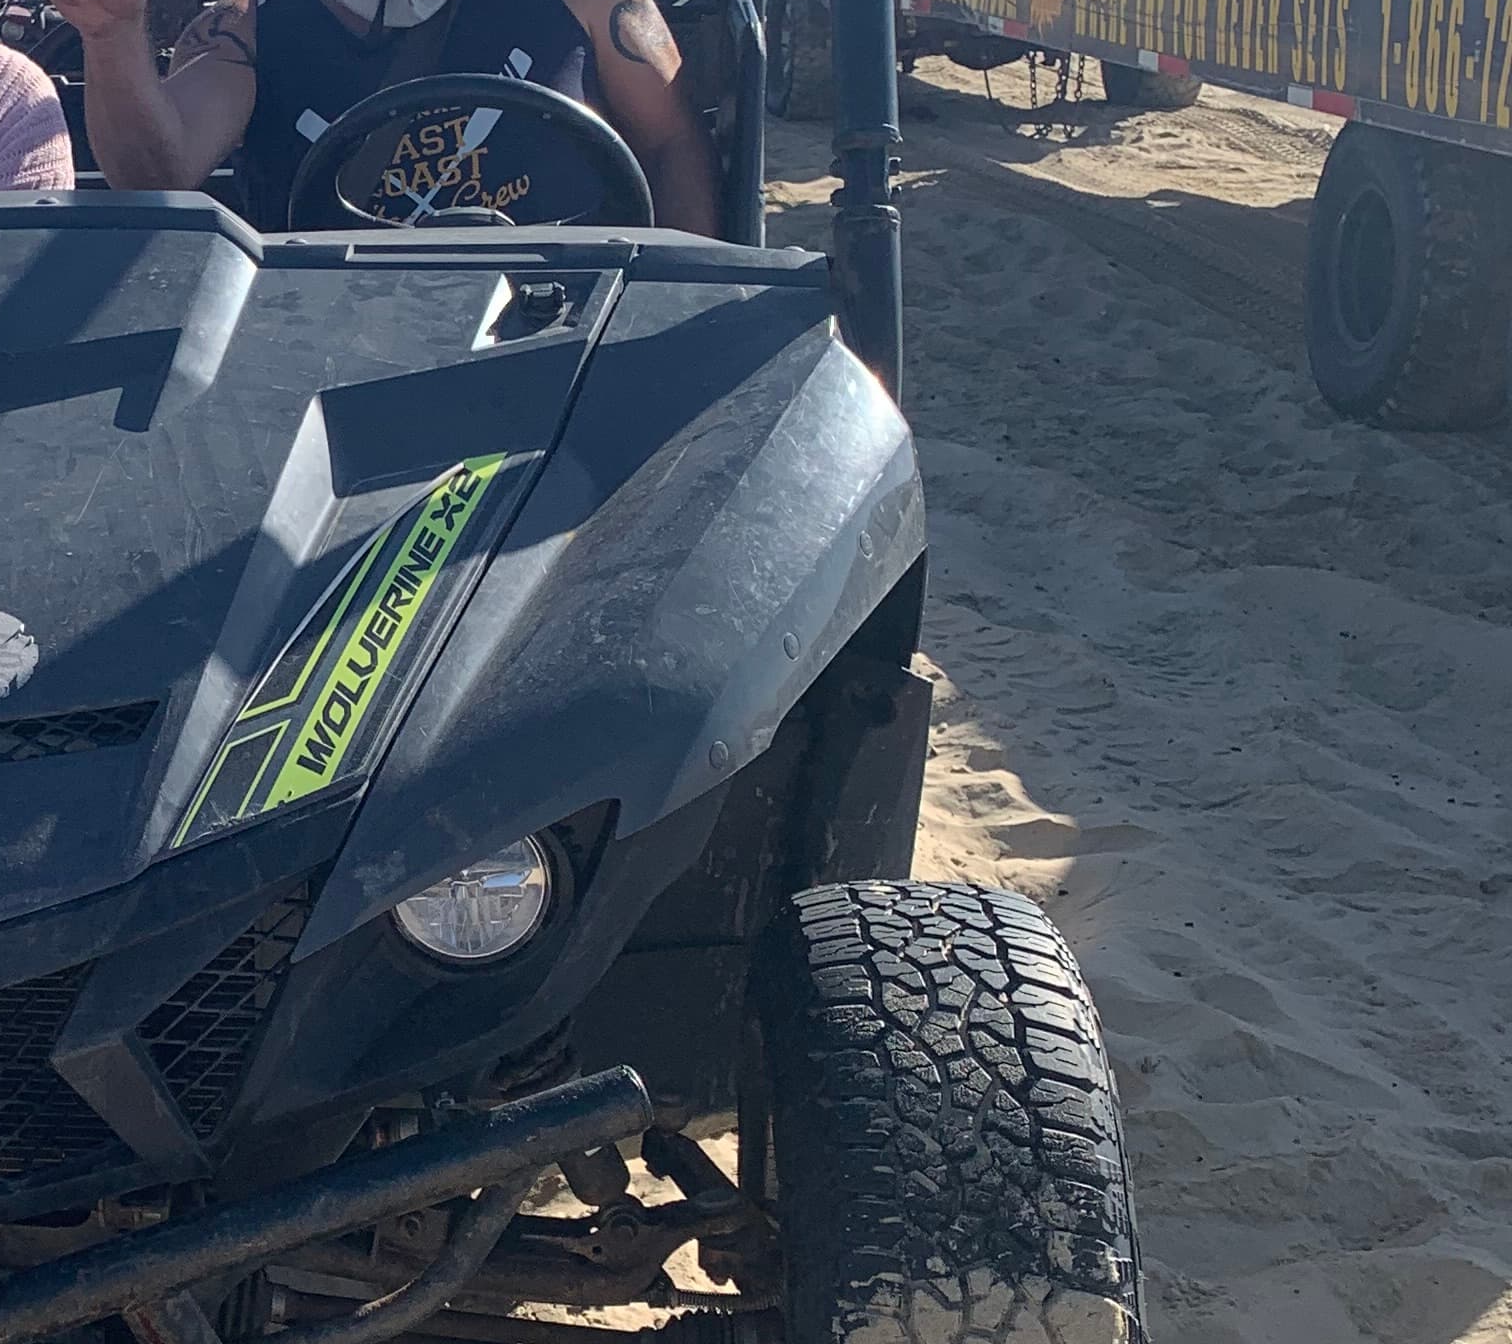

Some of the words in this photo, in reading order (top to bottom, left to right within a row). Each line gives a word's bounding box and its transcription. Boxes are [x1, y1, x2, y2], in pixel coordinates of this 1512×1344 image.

[392, 115, 470, 165] AST
[381, 146, 489, 197] OAST
[451, 173, 531, 209] Crew
[296, 527, 446, 776] WOLVERINE
[430, 466, 483, 533] X2
